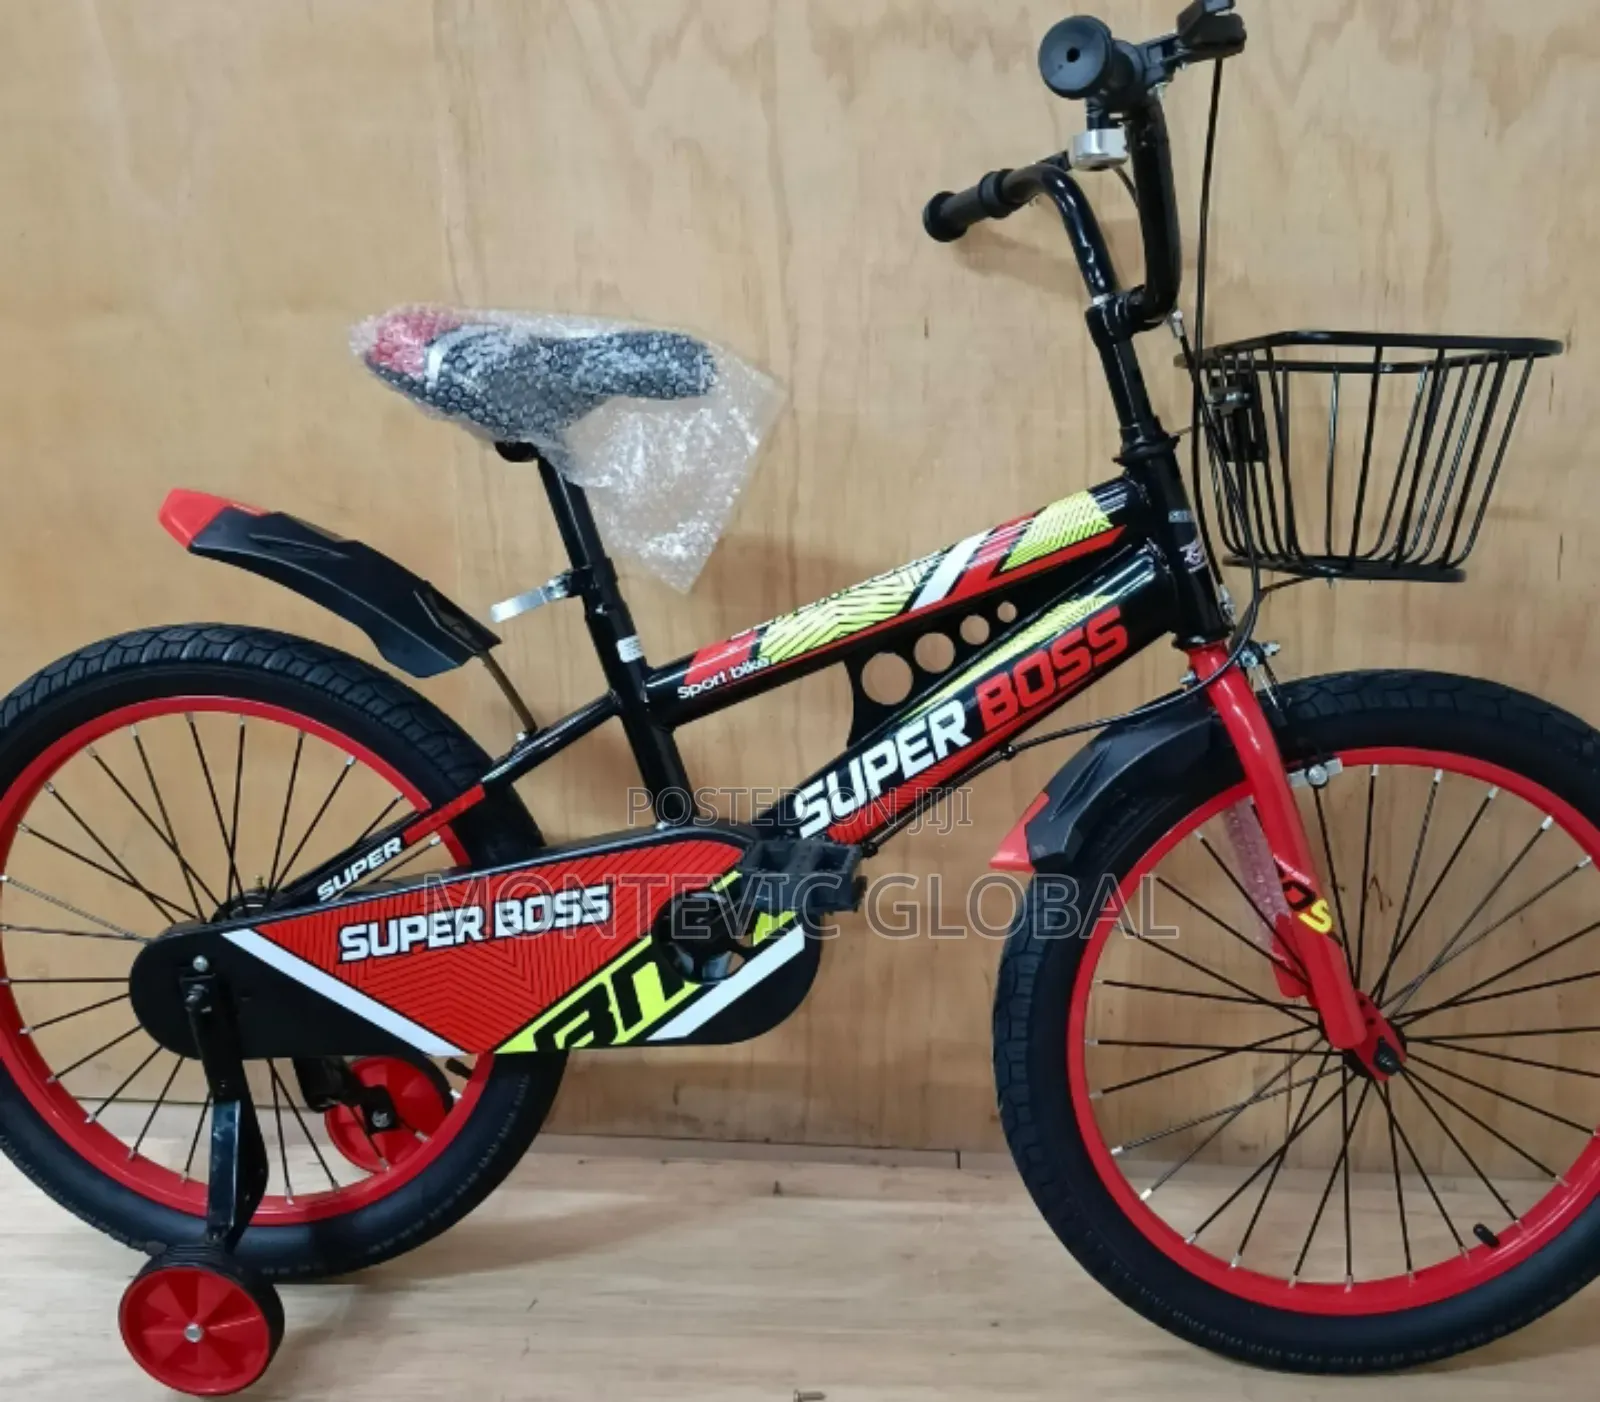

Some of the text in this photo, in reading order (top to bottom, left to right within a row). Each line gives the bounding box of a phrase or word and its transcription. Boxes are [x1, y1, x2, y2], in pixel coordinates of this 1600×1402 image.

[793, 606, 1128, 839] SUPER BOSS
[317, 837, 402, 902] SUPER
[340, 884, 611, 962] SUPER BOSS
